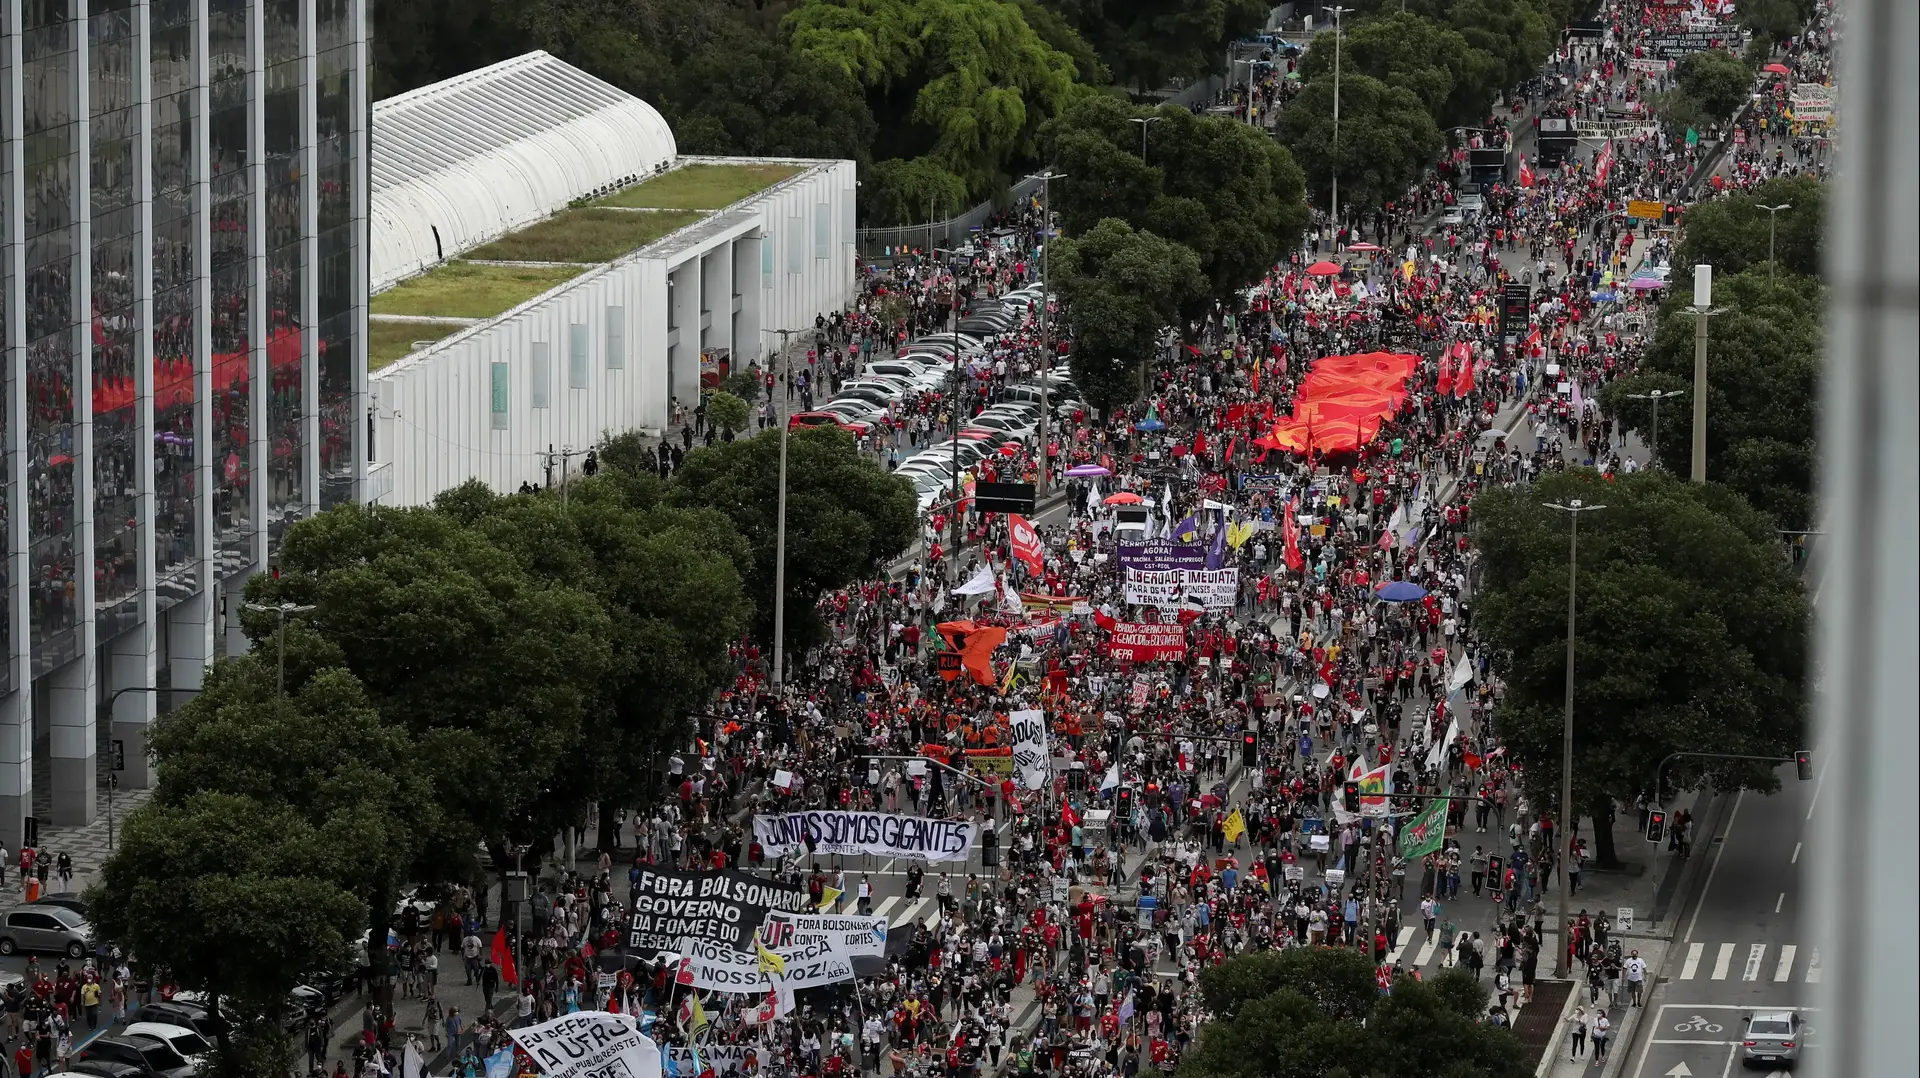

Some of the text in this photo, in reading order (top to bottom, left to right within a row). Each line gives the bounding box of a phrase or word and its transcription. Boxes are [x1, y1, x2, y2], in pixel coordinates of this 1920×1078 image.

[1120, 539, 1158, 547] DERROTAR
[1143, 547, 1172, 555] AGORA!
[1127, 568, 1236, 584] LIBERDADE IMEDIATA
[1128, 584, 1147, 594] PARA
[1150, 586, 1160, 594] OS
[1160, 586, 1166, 594] 4
[1168, 585, 1211, 594] CMPONESES
[1137, 595, 1164, 604] TERRA
[1110, 649, 1133, 660] MEPR
[766, 812, 970, 853] JUNTAS SOMOS GIGANTES
[640, 870, 800, 912] FORA BOLSONARO
[635, 895, 741, 923] GOVERNO
[632, 913, 740, 942] DA FOME E DO
[797, 919, 872, 931] FORA BOLSONARO
[845, 932, 873, 945] CORTES
[691, 941, 832, 966] NOSSA ORÇA
[702, 966, 771, 985] NOSSA
[827, 967, 850, 979] AERJ
[519, 1033, 543, 1049] EU
[538, 1019, 630, 1070] A UFRJ
